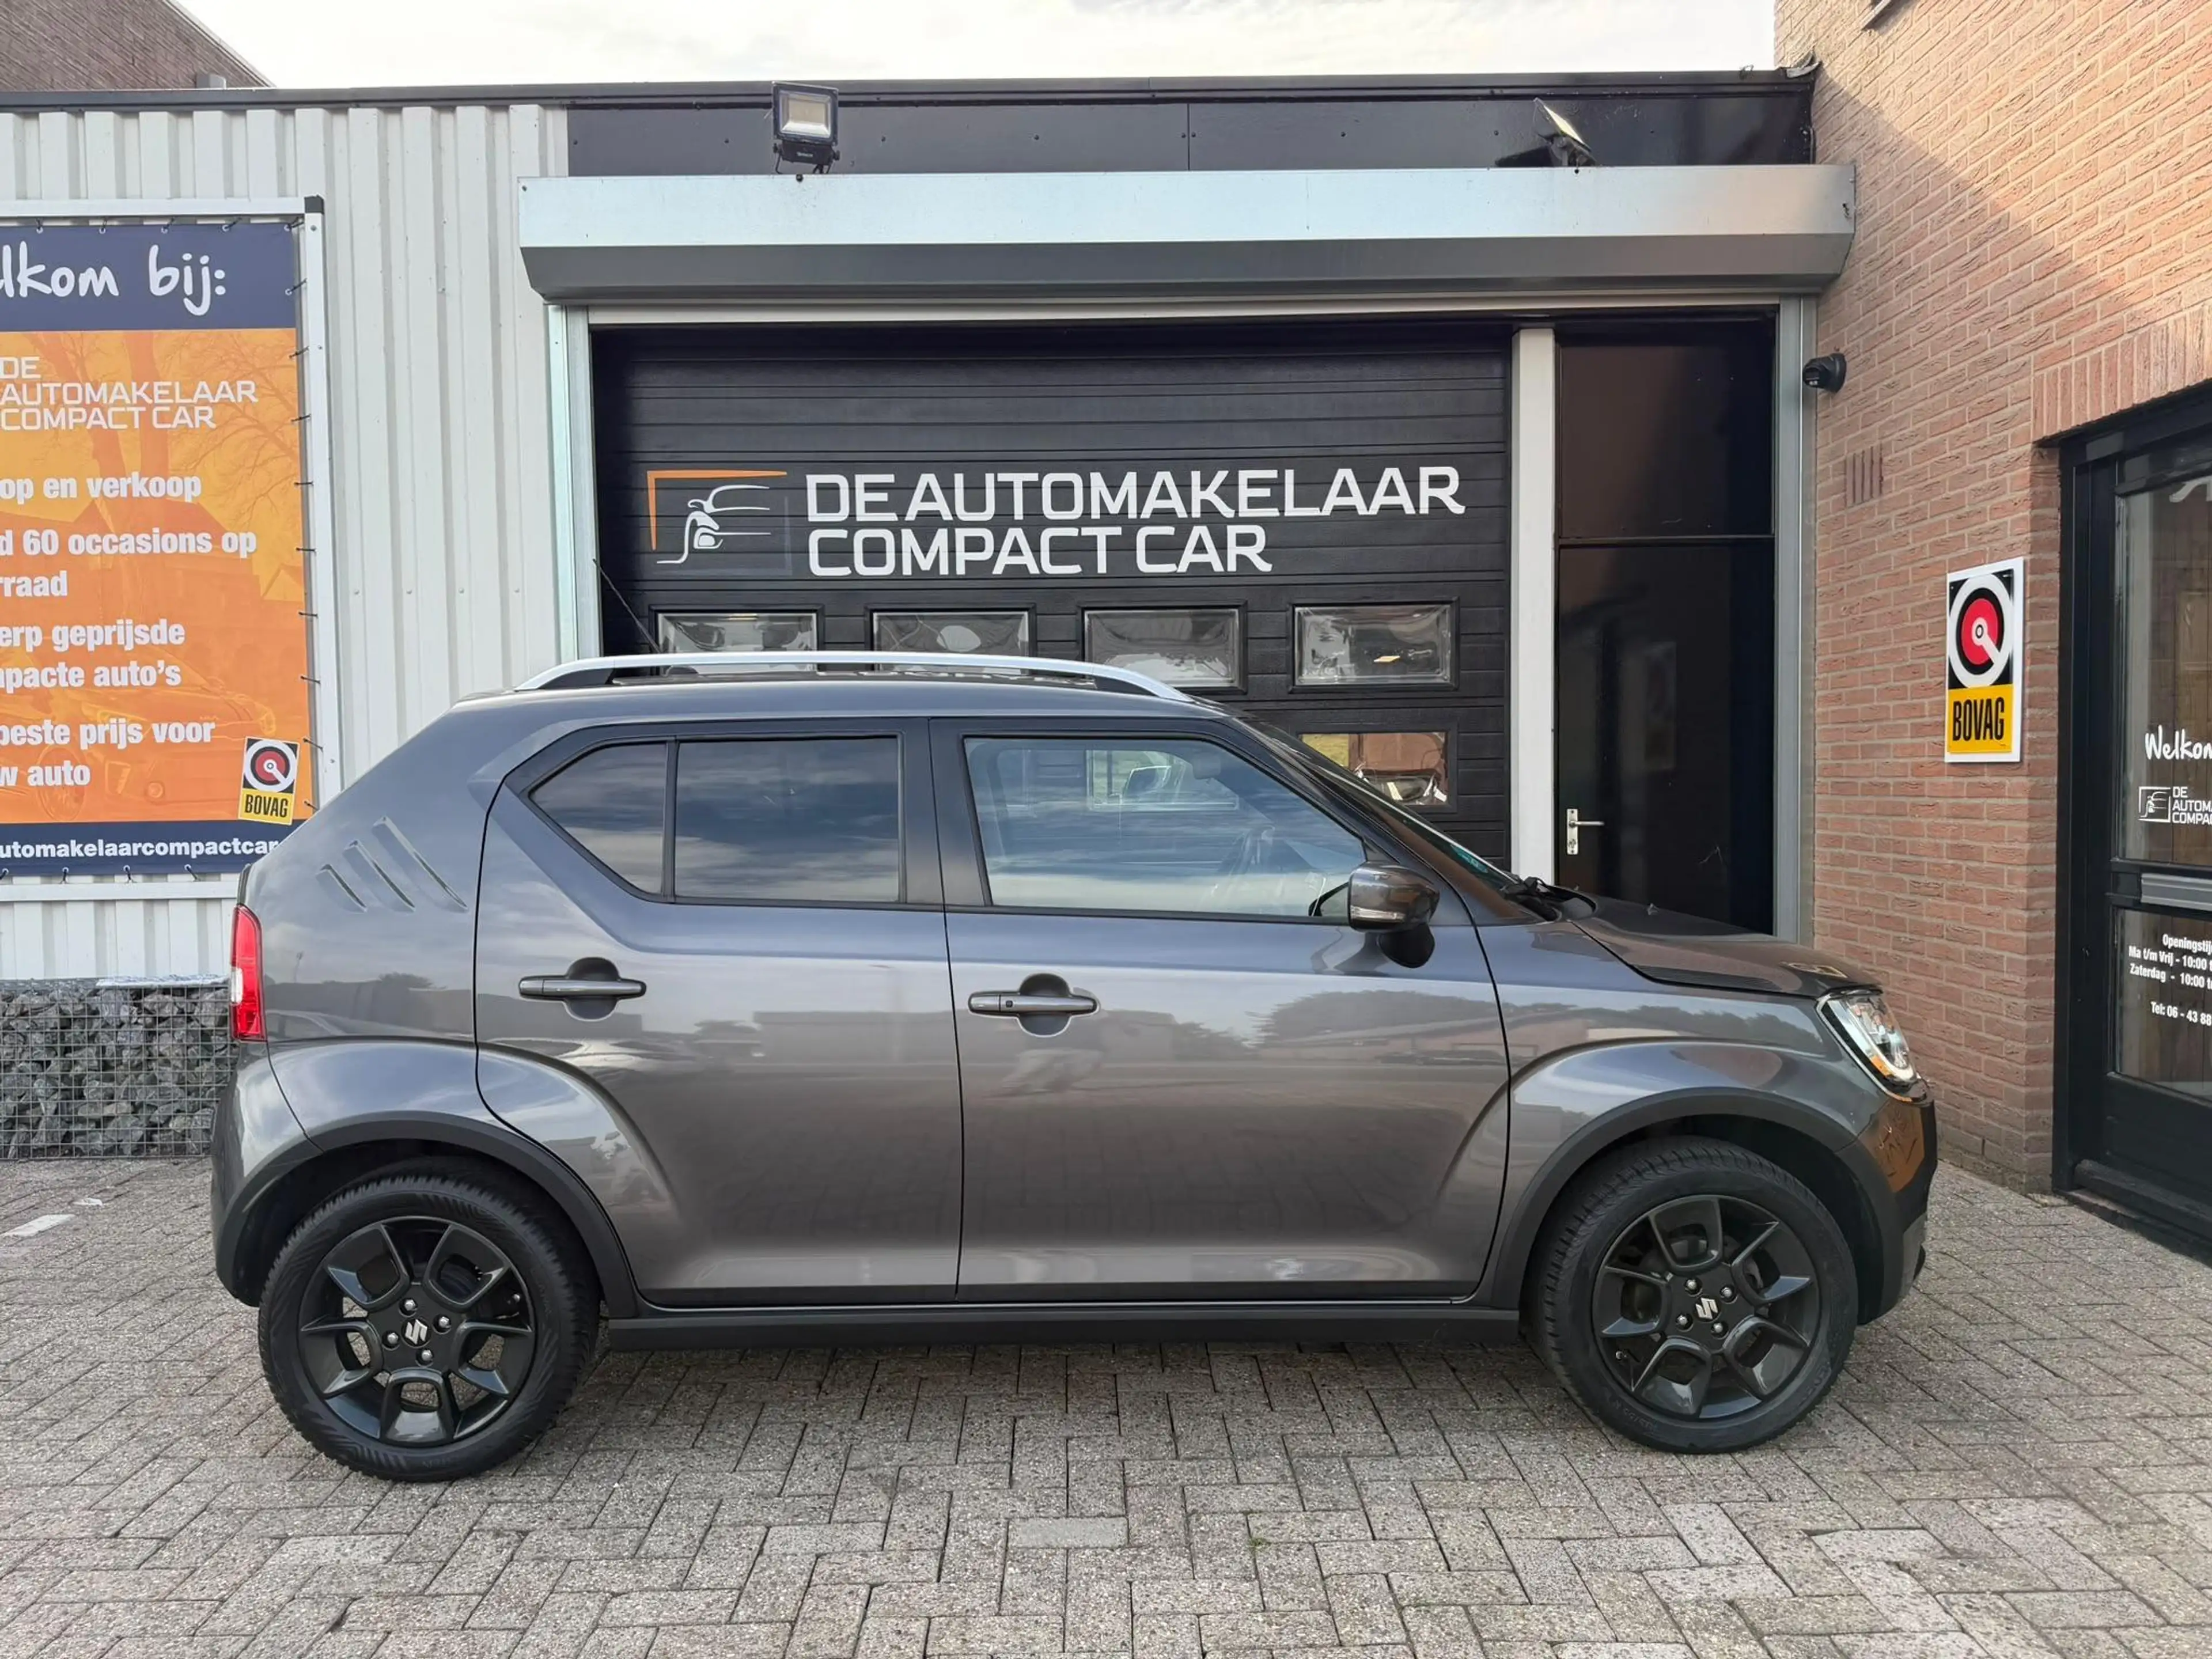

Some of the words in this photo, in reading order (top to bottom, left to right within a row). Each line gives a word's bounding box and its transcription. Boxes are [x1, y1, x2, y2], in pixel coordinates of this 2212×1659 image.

[0, 241, 119, 298] lkom
[149, 244, 226, 316] bij:
[0, 357, 41, 379] DE
[0, 380, 258, 407] AUTOMAKELAAR
[0, 406, 146, 431] COMPACT
[152, 406, 216, 429] CAR
[43, 478, 77, 499] en
[86, 471, 202, 503] verkoop
[806, 474, 899, 522] DE
[904, 466, 1465, 521] AUTOMAKELAAR
[22, 529, 59, 555] 60
[68, 527, 213, 555] occasions
[221, 532, 257, 559] op
[808, 527, 1122, 576] COMPACT
[1136, 525, 1272, 573] CAR
[0, 570, 68, 597] raad
[51, 619, 185, 653] geprijsde
[93, 660, 181, 687] auto's
[1952, 696, 2005, 741] BOVAG
[79, 718, 143, 751] prijs
[151, 722, 215, 743] voor
[27, 760, 91, 786] auto
[2172, 799, 2212, 812] AUTOM
[2173, 786, 2188, 798] DE
[244, 794, 288, 818] BOVAG
[2128, 945, 2141, 959] Ma
[2143, 948, 2158, 962] t/m
[2159, 950, 2174, 967] Vrij
[2182, 955, 2207, 970] 10:00
[2130, 963, 2166, 983] Zaterdag
[2180, 972, 2205, 988] 10:00
[2150, 1001, 2165, 1016] Tel:
[2166, 1005, 2178, 1018] 06
[2186, 1009, 2198, 1023] 43
[2200, 1012, 2212, 1027] 88
